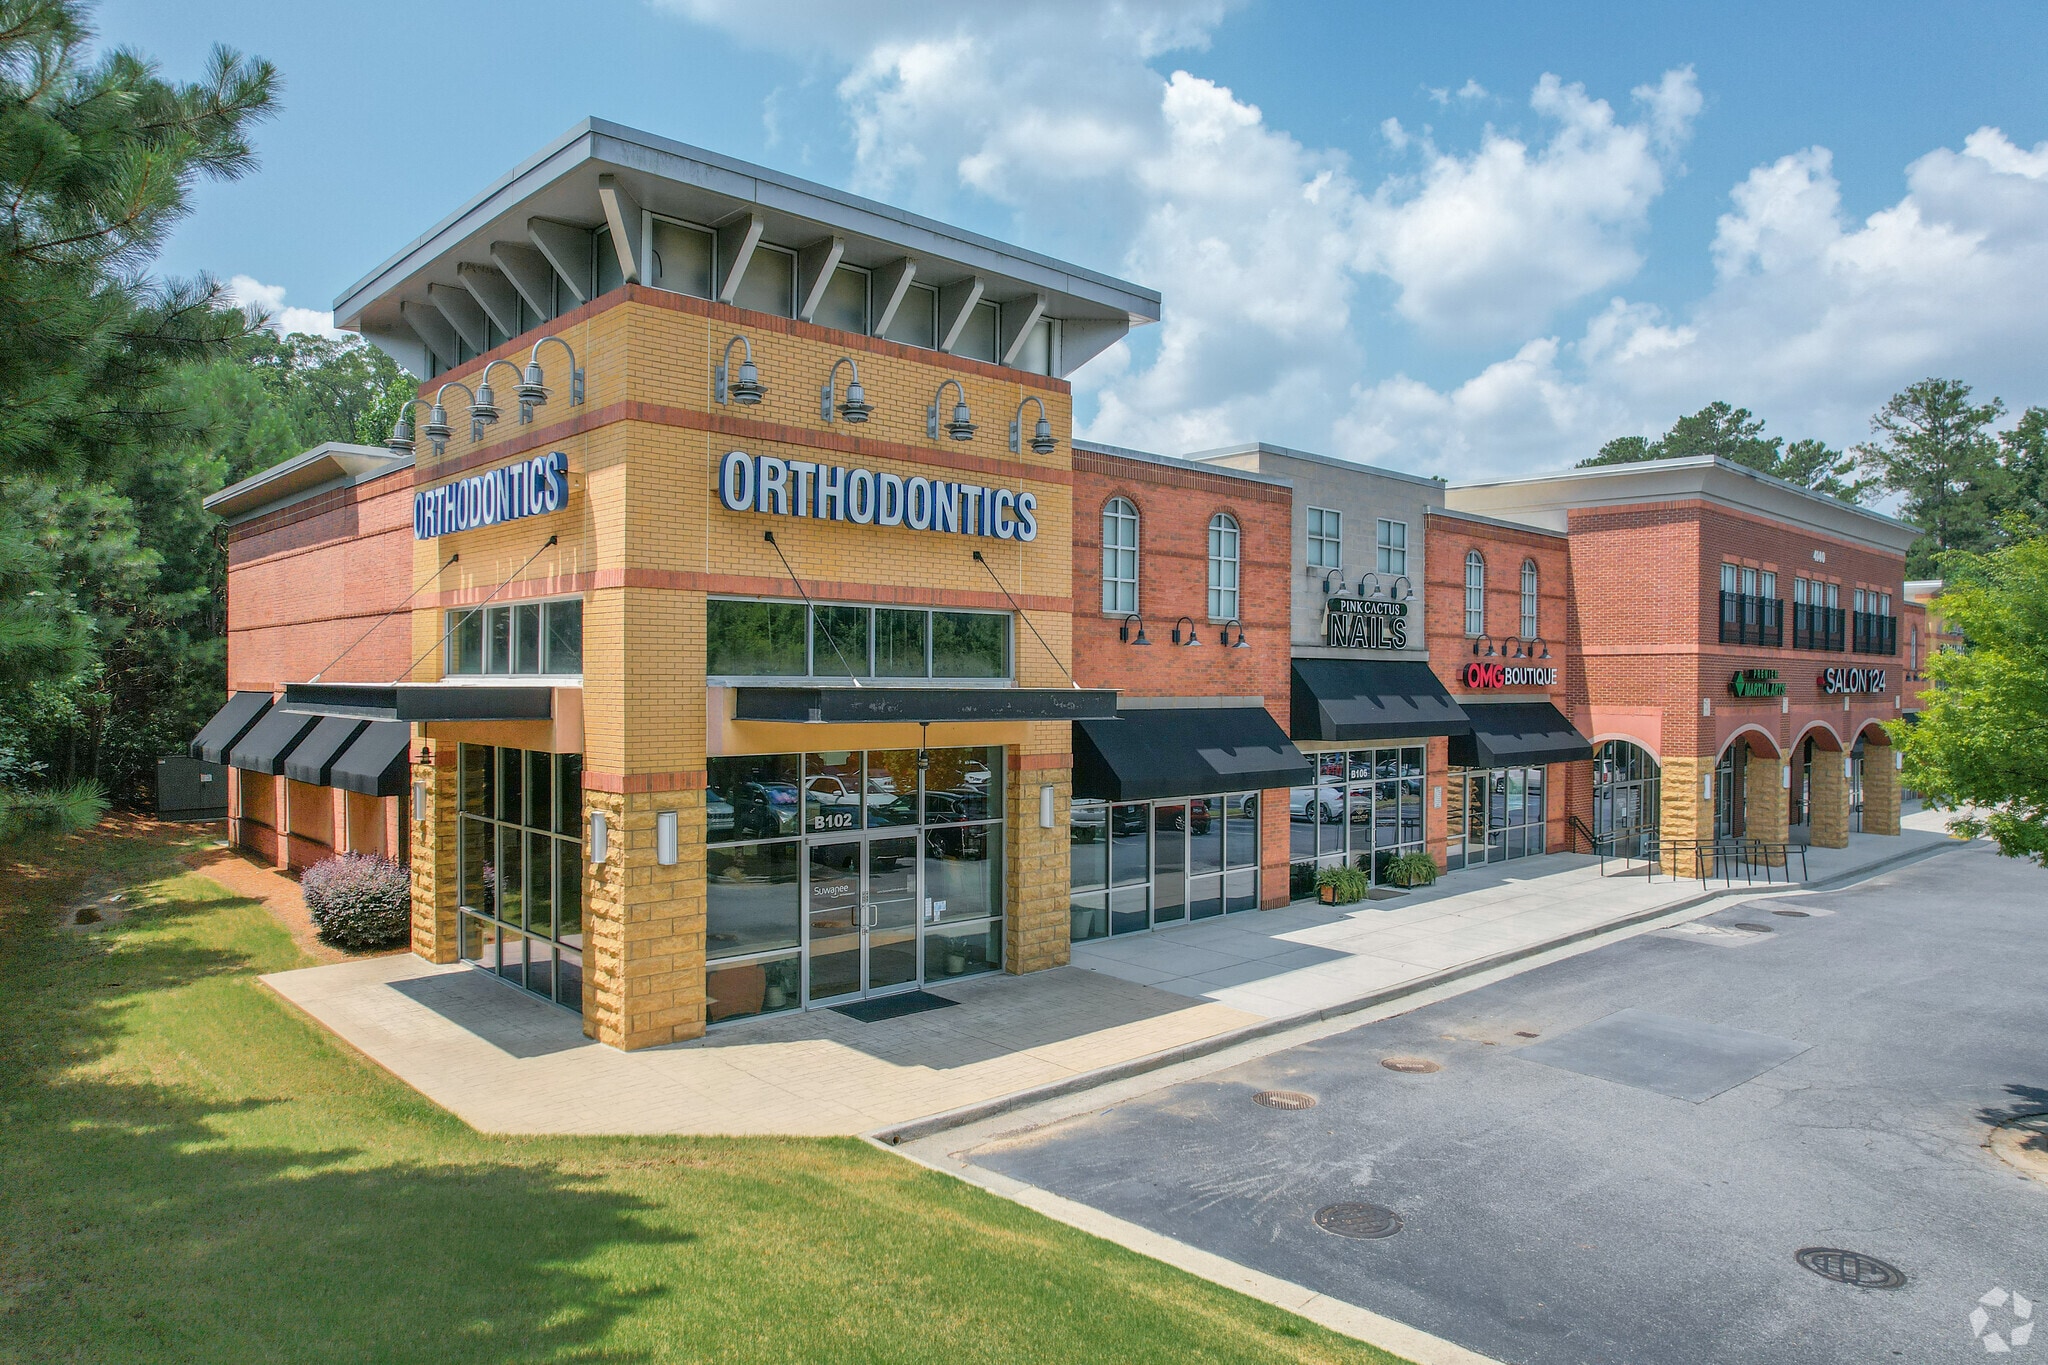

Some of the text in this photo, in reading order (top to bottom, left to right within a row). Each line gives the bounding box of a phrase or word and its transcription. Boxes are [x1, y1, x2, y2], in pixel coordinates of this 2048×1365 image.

[414, 452, 568, 540] ORTHODONTICS
[719, 451, 1037, 542] ORTHODONTICS
[1340, 600, 1400, 616] PINK CACTUS
[1329, 613, 1407, 649] NAILS
[1465, 662, 1558, 689] OMG BOUTIQUE
[1753, 669, 1779, 679] PREMIER
[1825, 667, 1886, 694] SALON 124
[1745, 682, 1786, 696] MARTIAL ARTS
[814, 813, 853, 830] B102
[814, 884, 849, 897] Suwanee
